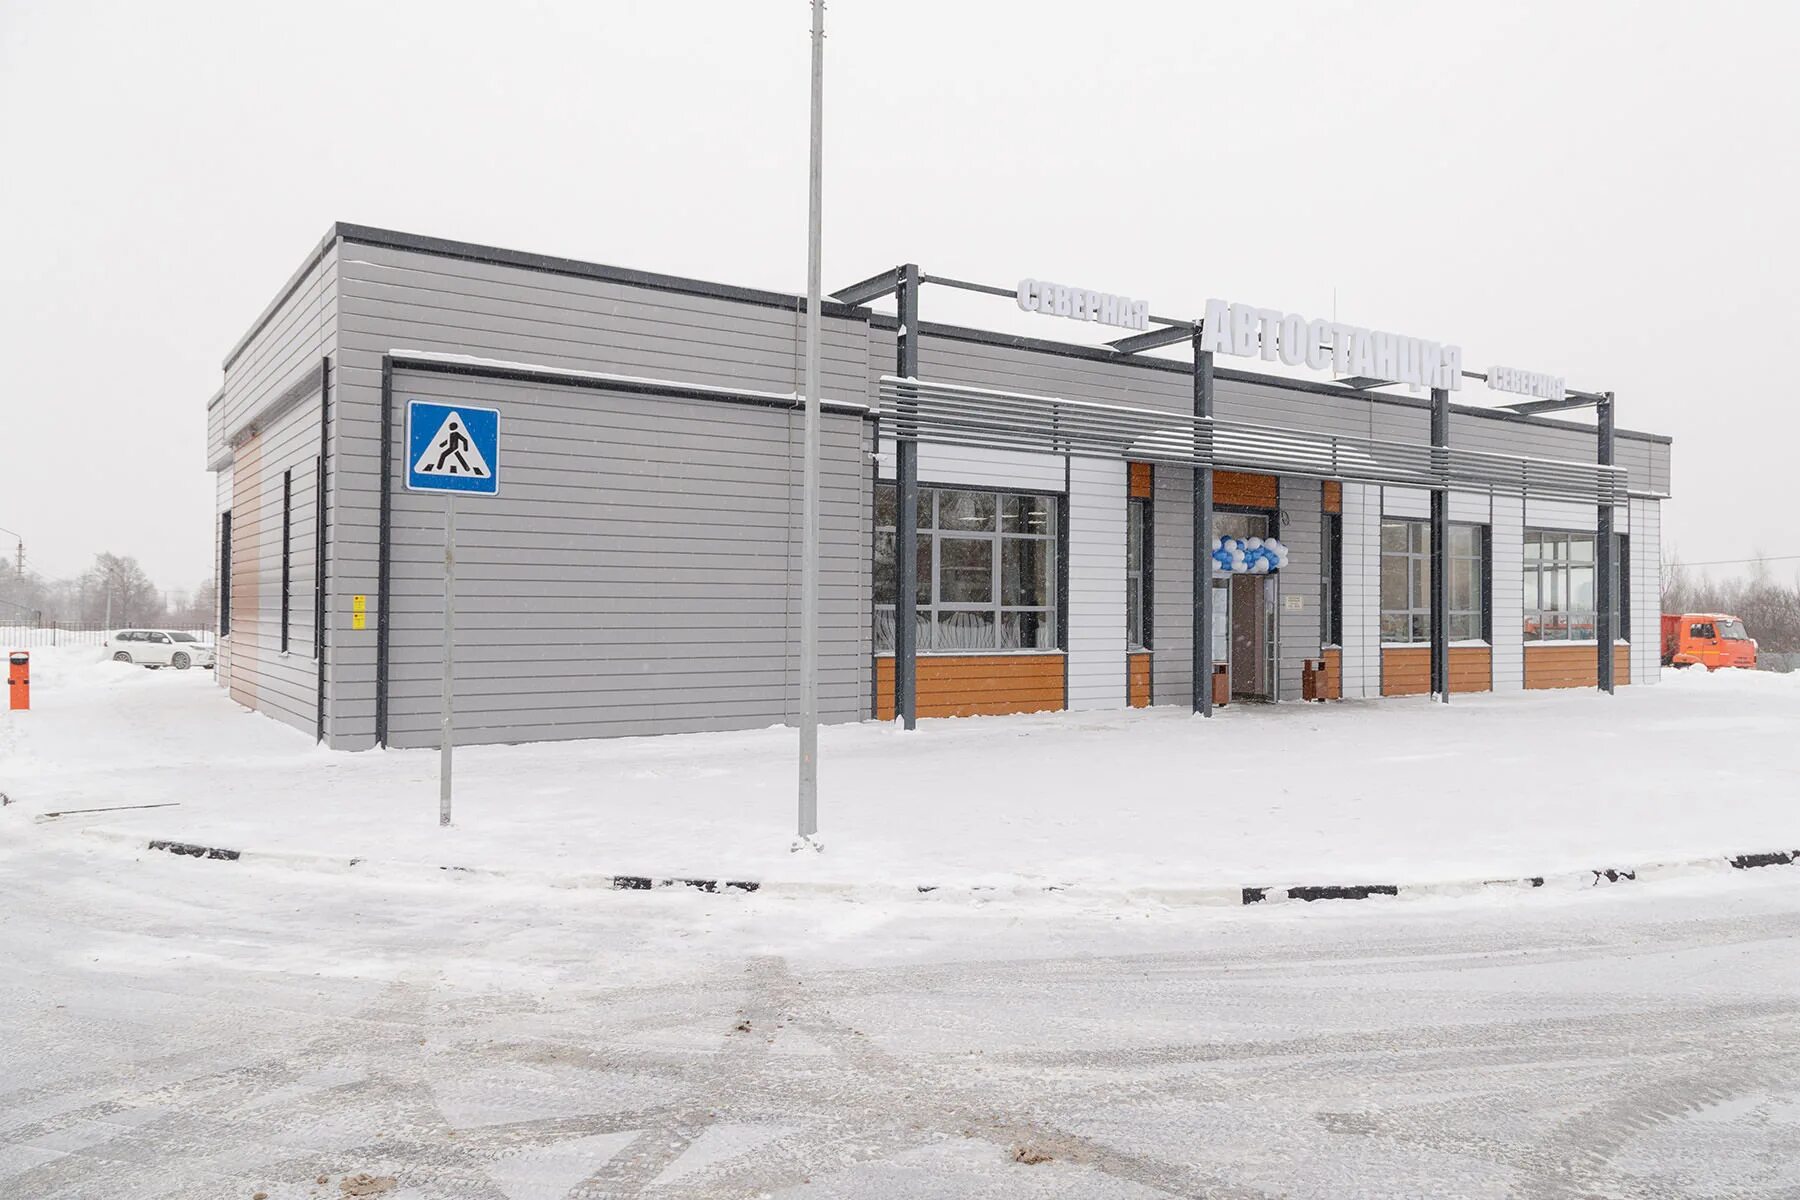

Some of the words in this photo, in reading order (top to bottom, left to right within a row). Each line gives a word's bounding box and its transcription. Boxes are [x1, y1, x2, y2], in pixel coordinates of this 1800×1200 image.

[1017, 279, 1149, 330] СЕВЕРНАЯ
[1202, 299, 1462, 392] АВТОСТАНЦИЯ
[1488, 366, 1566, 401] СЕВЕРНАЯ
